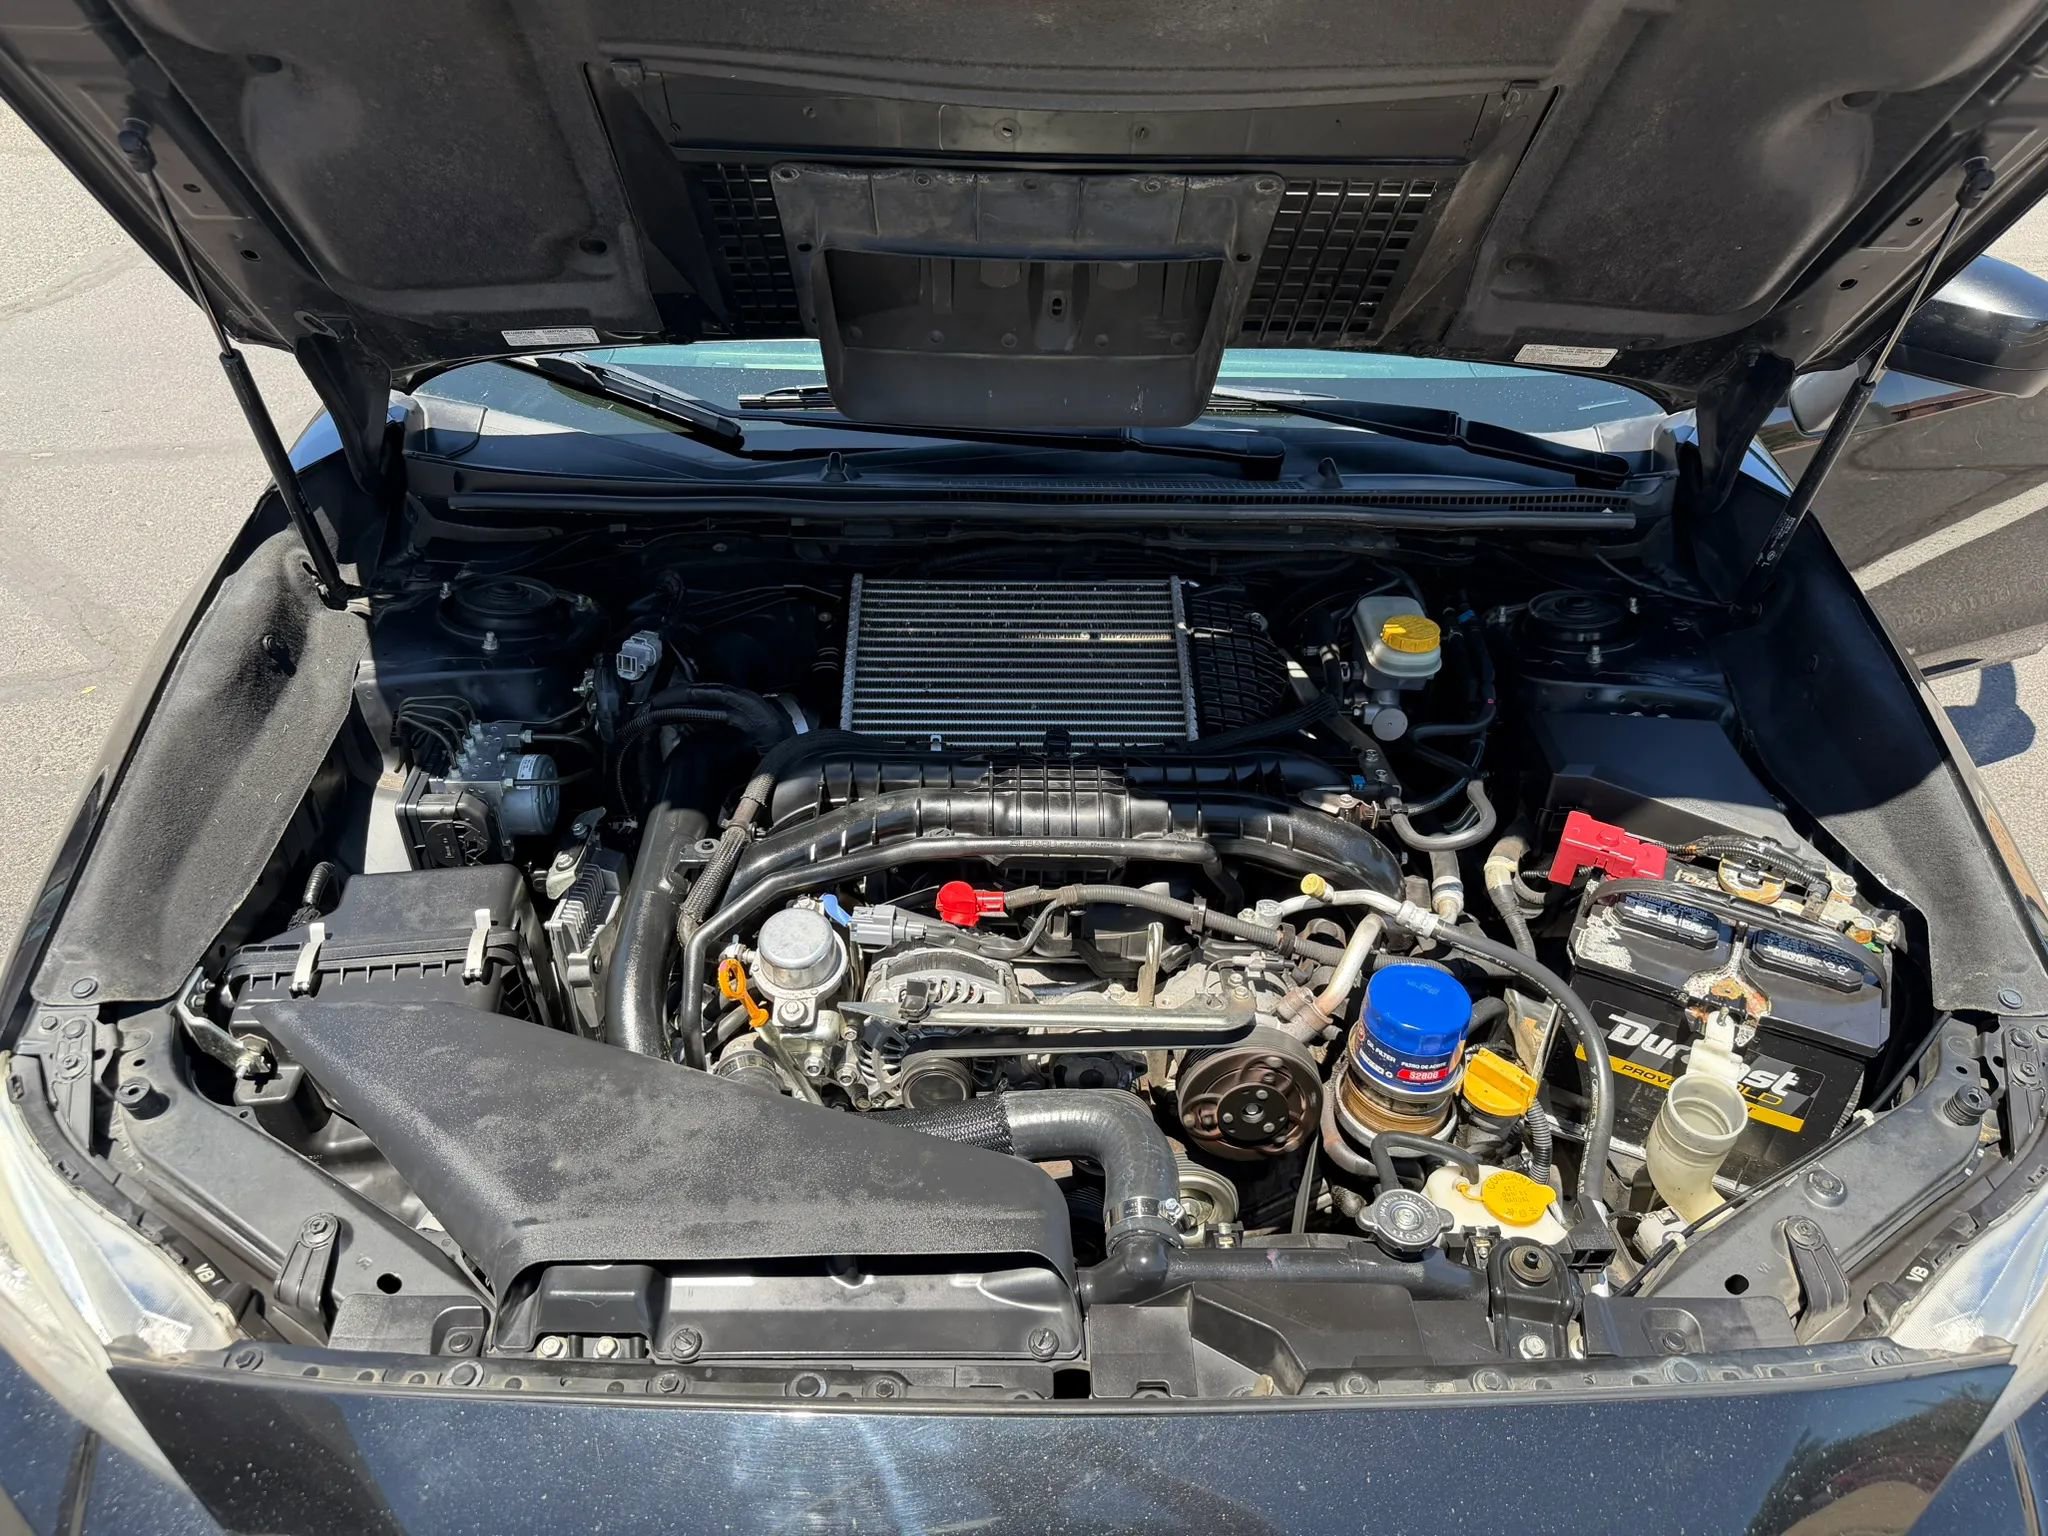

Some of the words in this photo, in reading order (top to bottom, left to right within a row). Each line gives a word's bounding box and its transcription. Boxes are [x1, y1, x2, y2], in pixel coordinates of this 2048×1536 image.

[1679, 904, 1708, 917] POISON
[1375, 1047, 1397, 1063] FILTER
[1608, 1013, 1800, 1097] Durst
[1622, 1064, 1676, 1087] PROV
[1737, 1083, 1783, 1105] LD
[1905, 1265, 1930, 1283] VB
